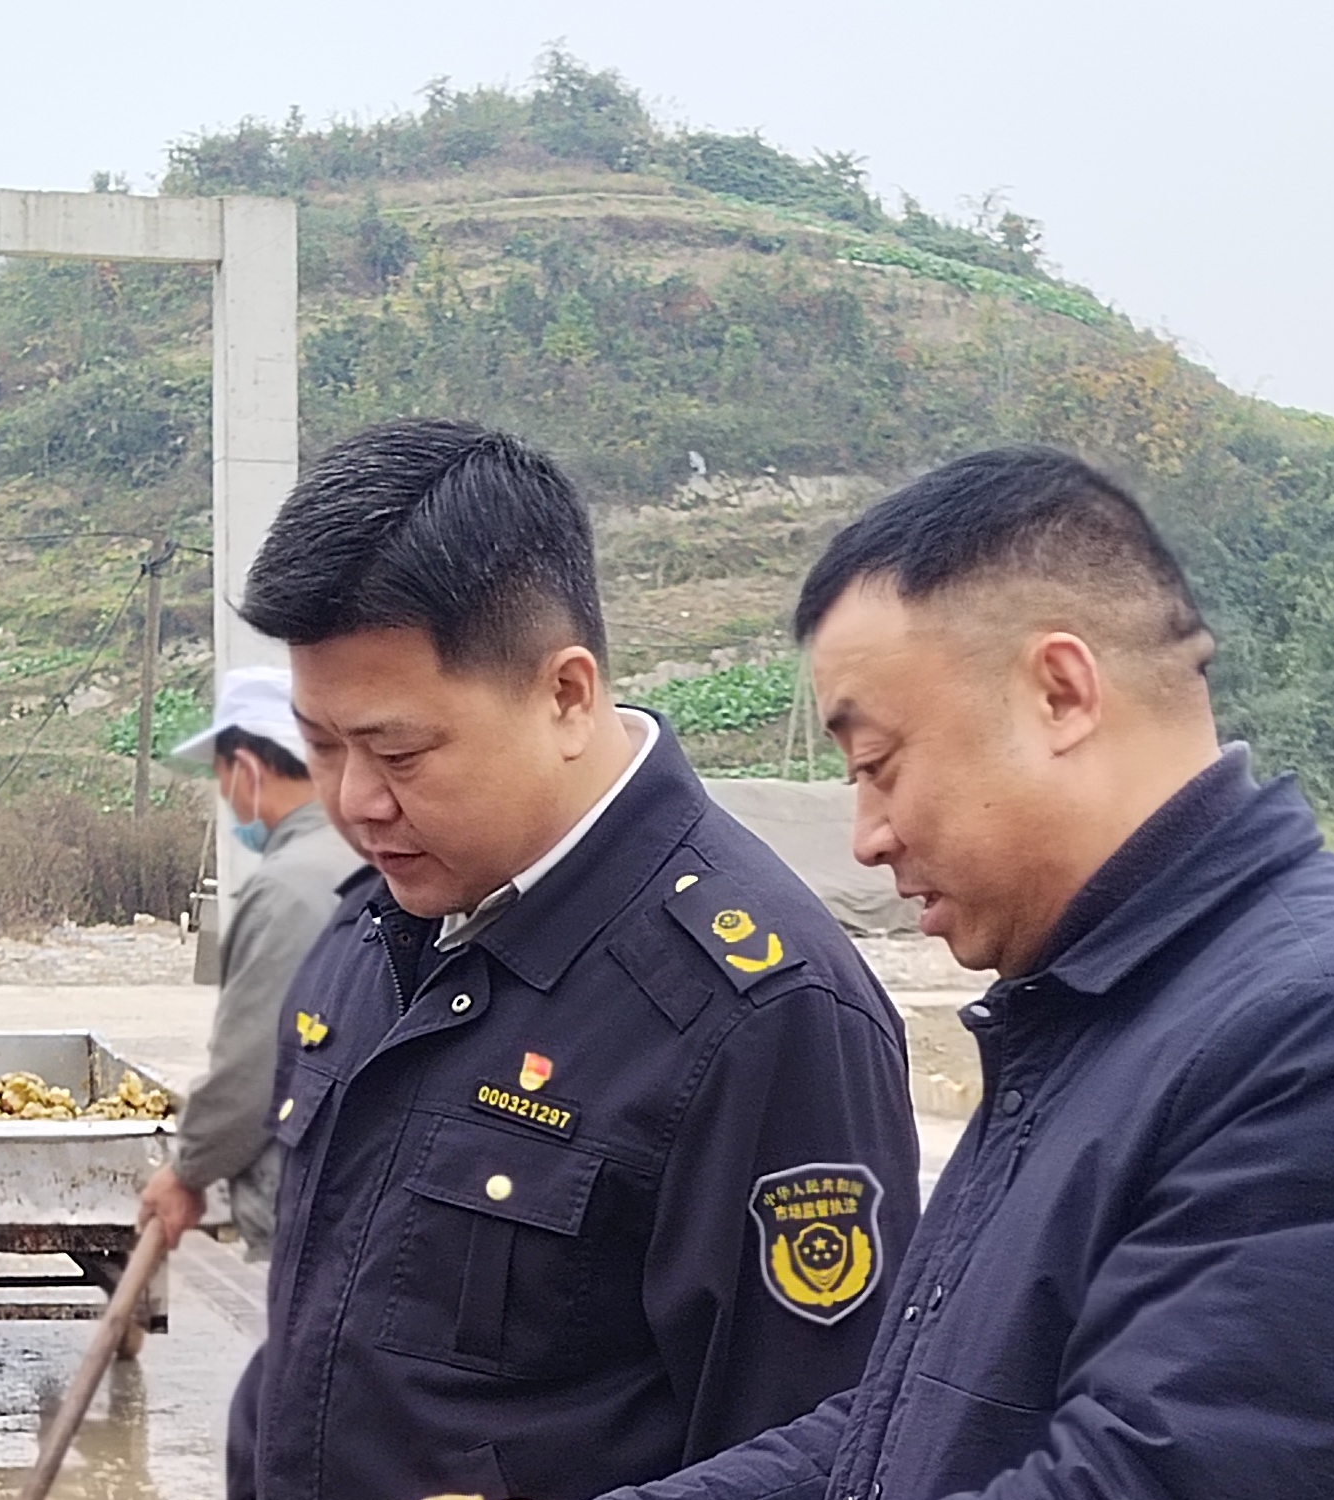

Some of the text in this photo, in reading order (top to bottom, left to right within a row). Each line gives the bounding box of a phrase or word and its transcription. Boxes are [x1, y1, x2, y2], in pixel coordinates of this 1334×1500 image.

[478, 1085, 571, 1129] 000321297
[774, 1197, 858, 1221] 市场监管执法
